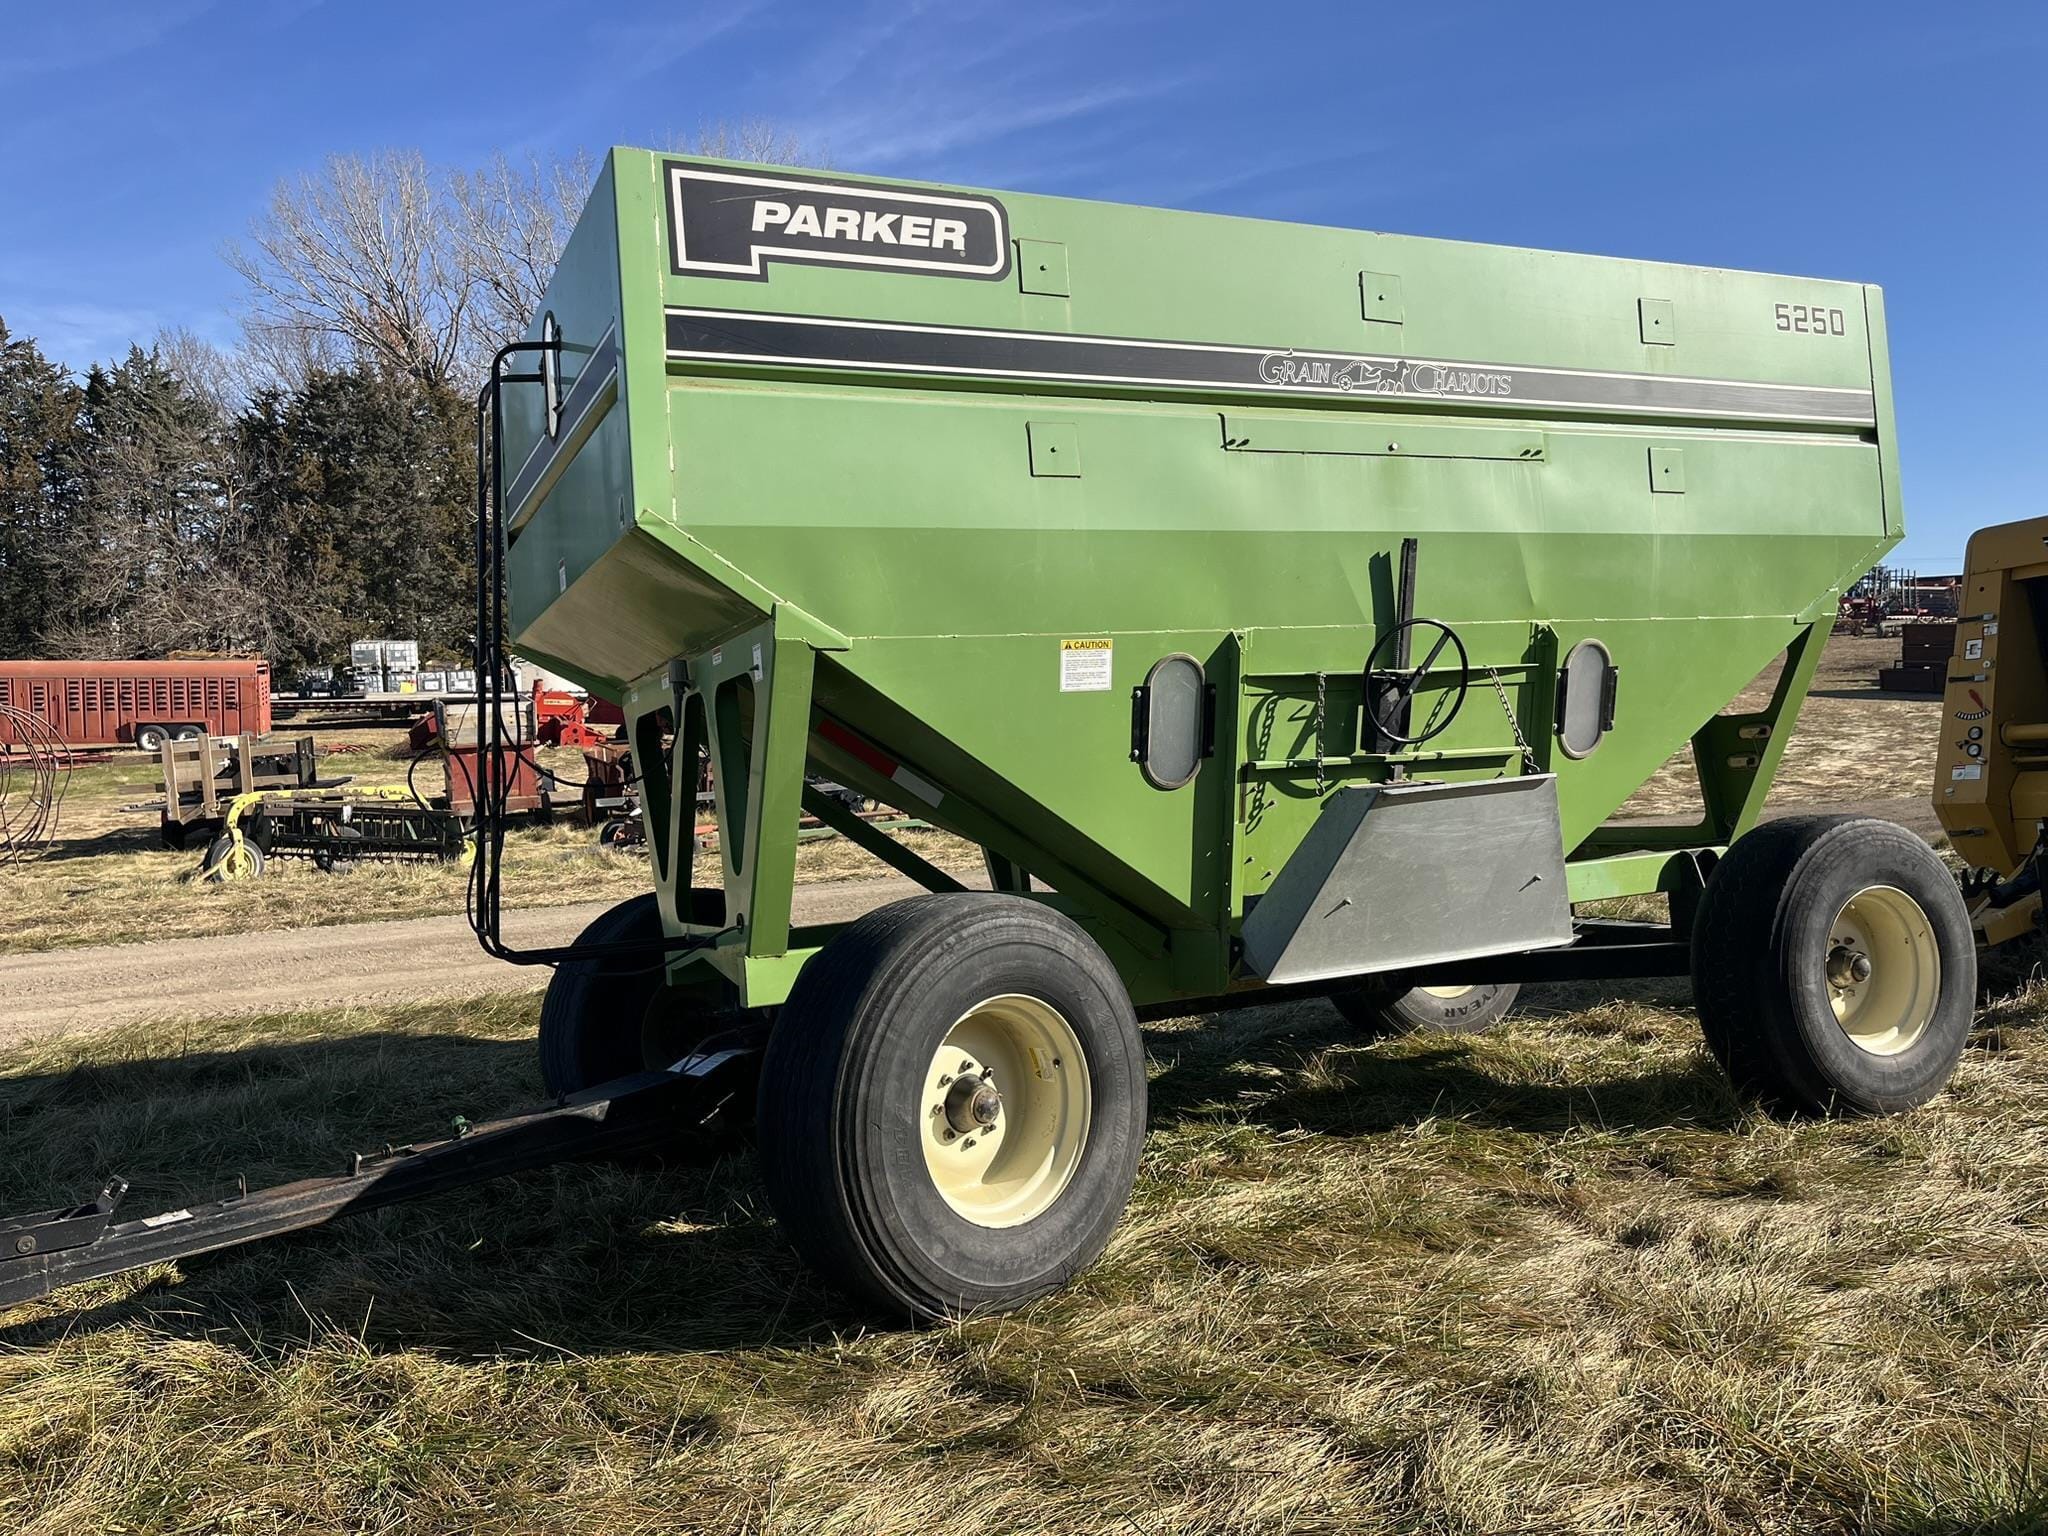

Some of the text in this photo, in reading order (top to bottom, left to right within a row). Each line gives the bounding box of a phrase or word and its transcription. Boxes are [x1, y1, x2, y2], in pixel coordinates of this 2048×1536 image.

[751, 200, 967, 250] PARKER
[1775, 303, 1845, 336] 5250
[1073, 641, 1109, 649] CAUTION
